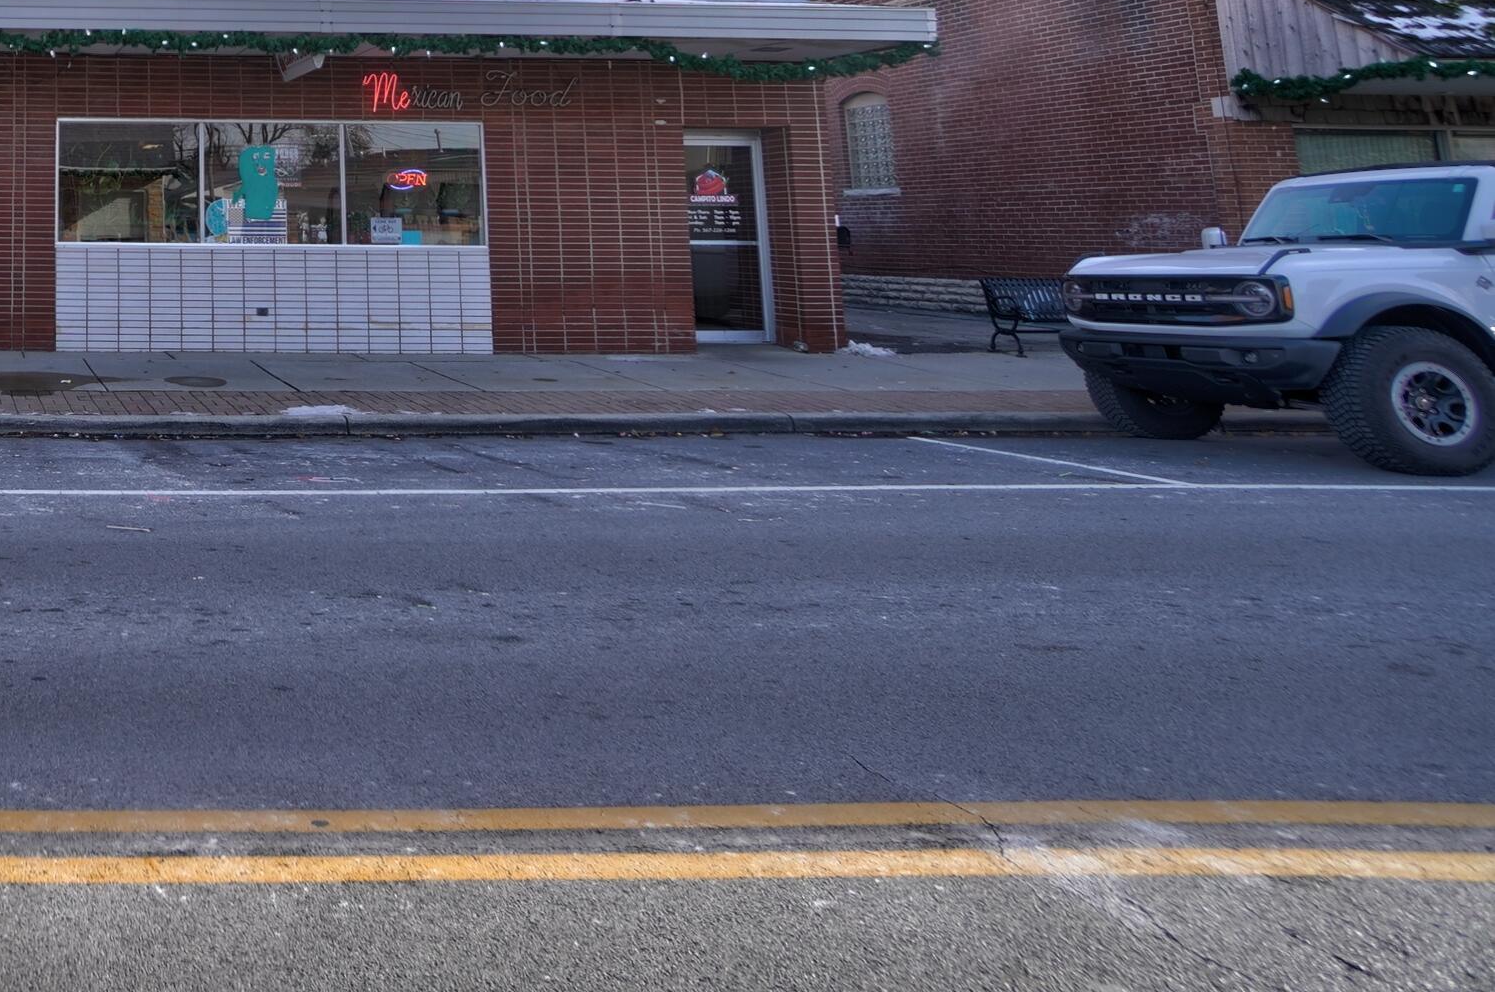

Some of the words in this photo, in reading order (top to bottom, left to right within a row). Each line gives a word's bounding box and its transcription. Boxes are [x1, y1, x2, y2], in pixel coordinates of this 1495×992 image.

[362, 71, 463, 112] Mexican
[480, 69, 578, 107] Food
[243, 236, 287, 244] ENFORCEMENT
[1094, 292, 1203, 302] BRONCO
